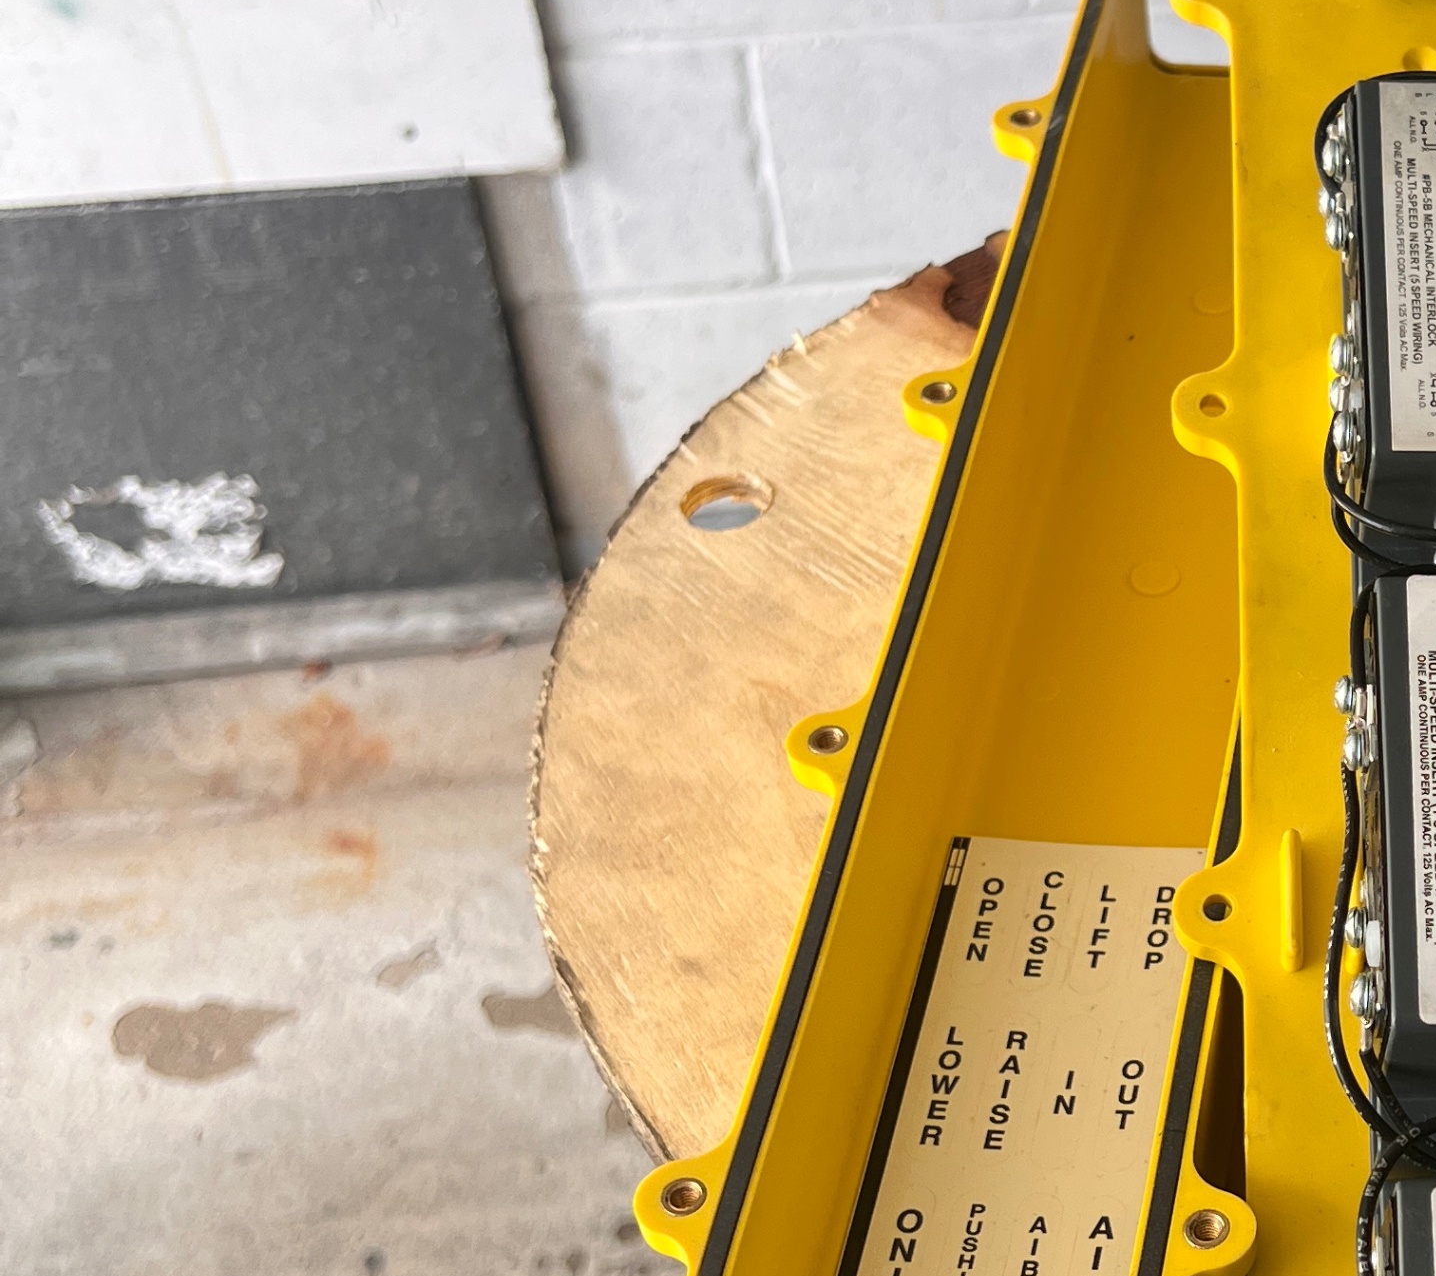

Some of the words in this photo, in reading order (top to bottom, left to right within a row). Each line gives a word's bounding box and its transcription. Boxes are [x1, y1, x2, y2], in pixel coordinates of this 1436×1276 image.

[1393, 140, 1402, 158] ONE
[1394, 160, 1402, 178] AMP
[1394, 180, 1404, 235] CONTINUOUS
[1406, 158, 1418, 228] MULTI-SPEED
[1421, 173, 1432, 211] #PB-5B
[1396, 238, 1405, 255] PER
[1408, 232, 1419, 271] INSERT
[1422, 213, 1435, 283] MECHANICAL
[1397, 257, 1406, 297] CONTACT.
[1409, 274, 1419, 284] (5
[1398, 303, 1407, 316] 125
[1410, 285, 1421, 319] SPEED
[1425, 286, 1436, 347] INTERLOCK
[1399, 318, 1407, 338] Volts
[1399, 339, 1408, 352] AC
[1411, 322, 1422, 364] WIRING)
[1400, 353, 1408, 372] Max.
[1416, 654, 1426, 680] ONE
[1417, 683, 1427, 701] AMP
[1418, 704, 1429, 771] CONTINUOUS
[1420, 773, 1429, 795] PER
[1420, 798, 1431, 849] CONTACT.
[1422, 852, 1431, 869] 125
[1423, 871, 1432, 896] Volts
[965, 877, 1005, 962] OPEN
[1023, 871, 1065, 978] CLOSE
[1423, 899, 1433, 915] AC
[1087, 884, 1117, 969] LIFT
[1143, 886, 1176, 970] DROP
[1424, 917, 1433, 941] Max.
[918, 1025, 964, 1147] LOWER
[982, 1030, 1028, 1151] RAISE
[1053, 1070, 1076, 1115] IN
[1114, 1059, 1144, 1130] OUT
